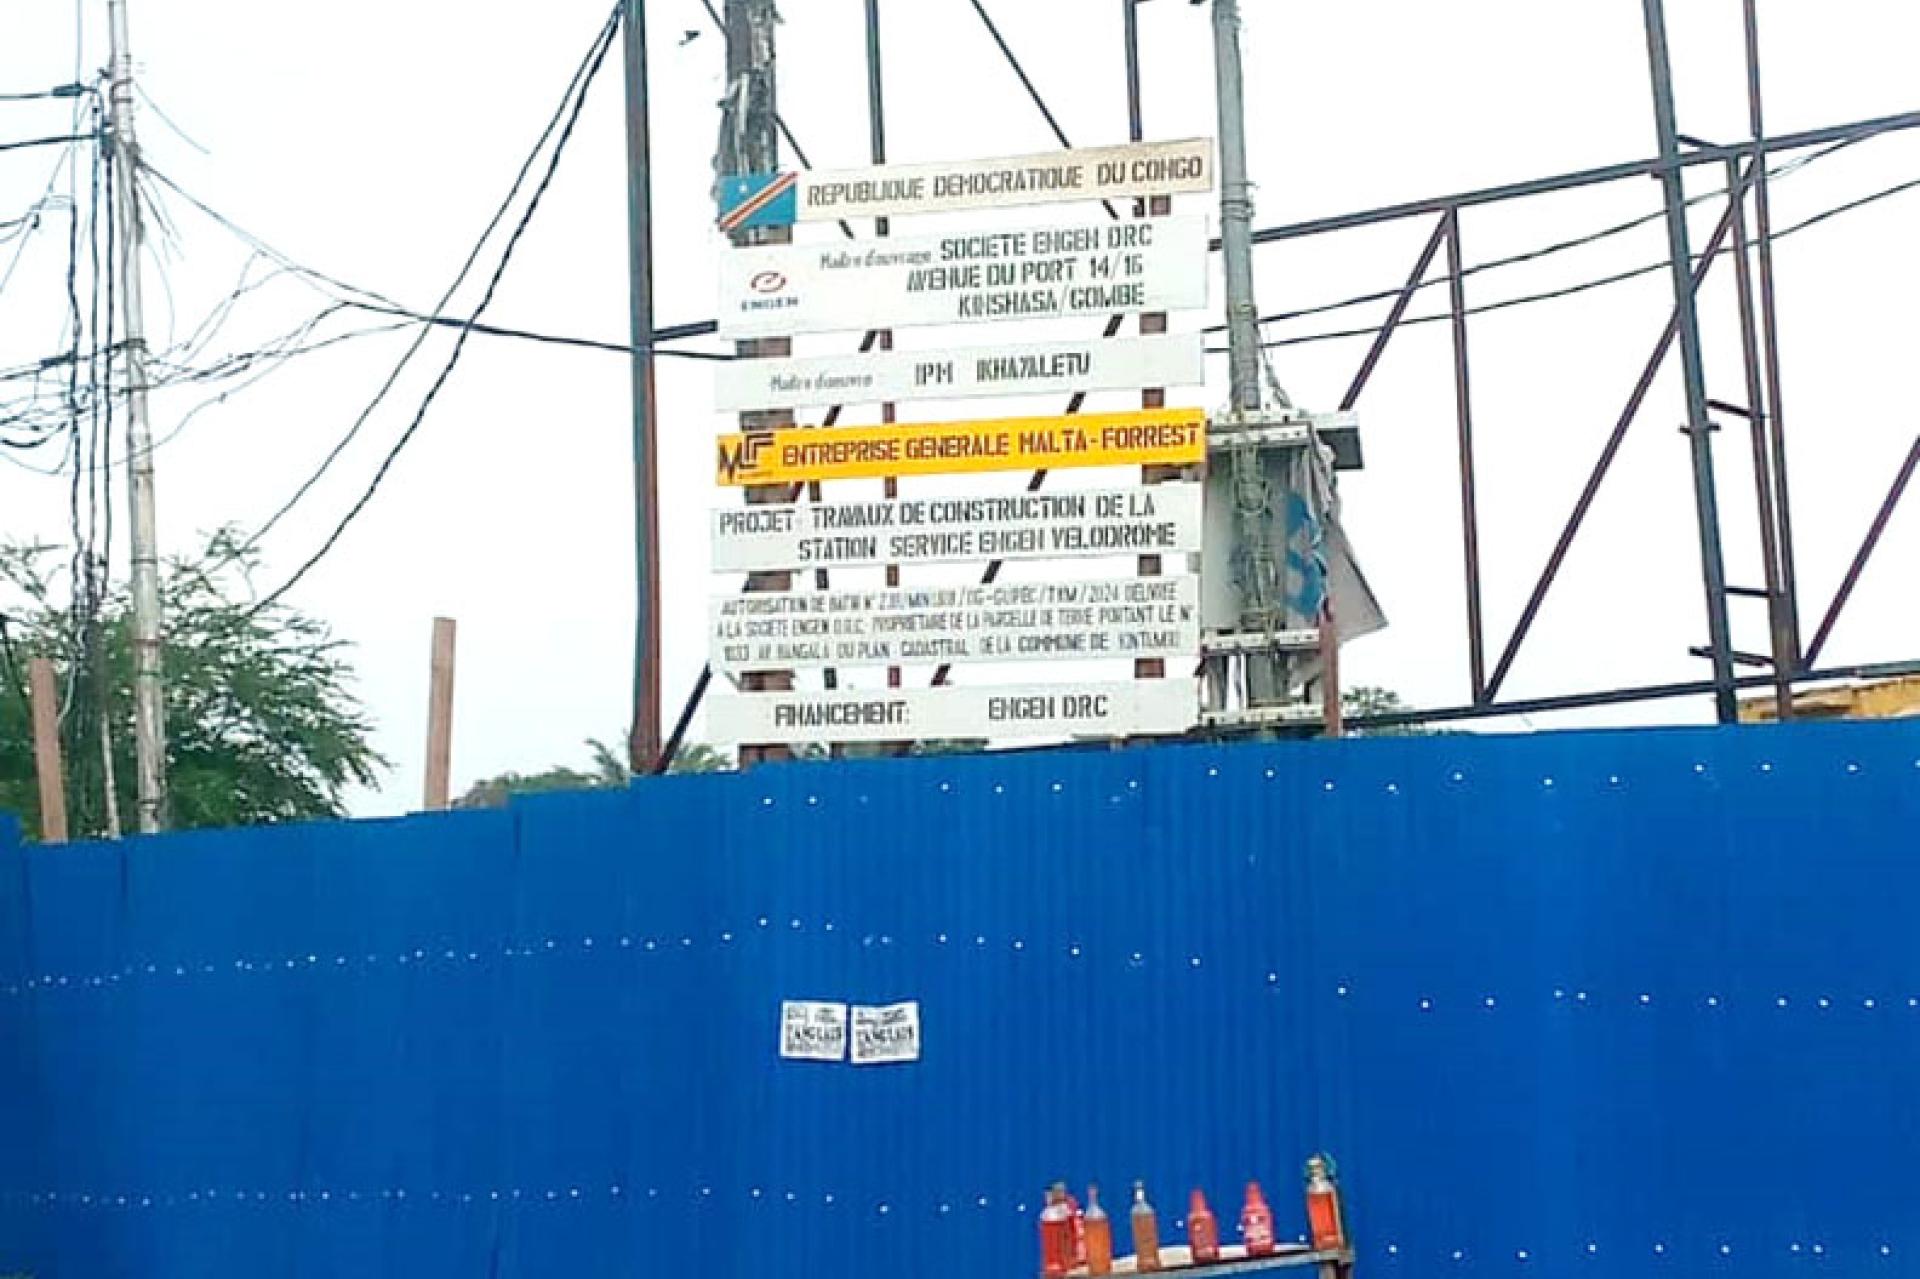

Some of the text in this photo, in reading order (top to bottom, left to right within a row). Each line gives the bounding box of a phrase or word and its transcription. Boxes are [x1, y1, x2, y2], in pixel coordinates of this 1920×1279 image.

[807, 156, 1203, 207] REPUBLIQUE DEMOCRATIQUE DU CONGO
[940, 223, 1153, 261] SOCIETE ENGEN DRC
[906, 265, 981, 292] AVENUE
[986, 261, 1017, 286] DU
[1022, 257, 1078, 285] PORT
[915, 359, 954, 386] IPM
[782, 436, 900, 468] ENTREPRISE
[906, 431, 1009, 461] GENERALE
[810, 502, 894, 529] TRAVAUX
[901, 500, 925, 525] DE
[930, 493, 1085, 524] CONSTRUCTION
[1096, 493, 1123, 518] DE
[1129, 492, 1155, 517] LA
[799, 520, 1176, 561] STATION SERVICE ENGEN VELODROME
[988, 696, 1055, 721] ENGEN
[1063, 693, 1108, 719] DRC
